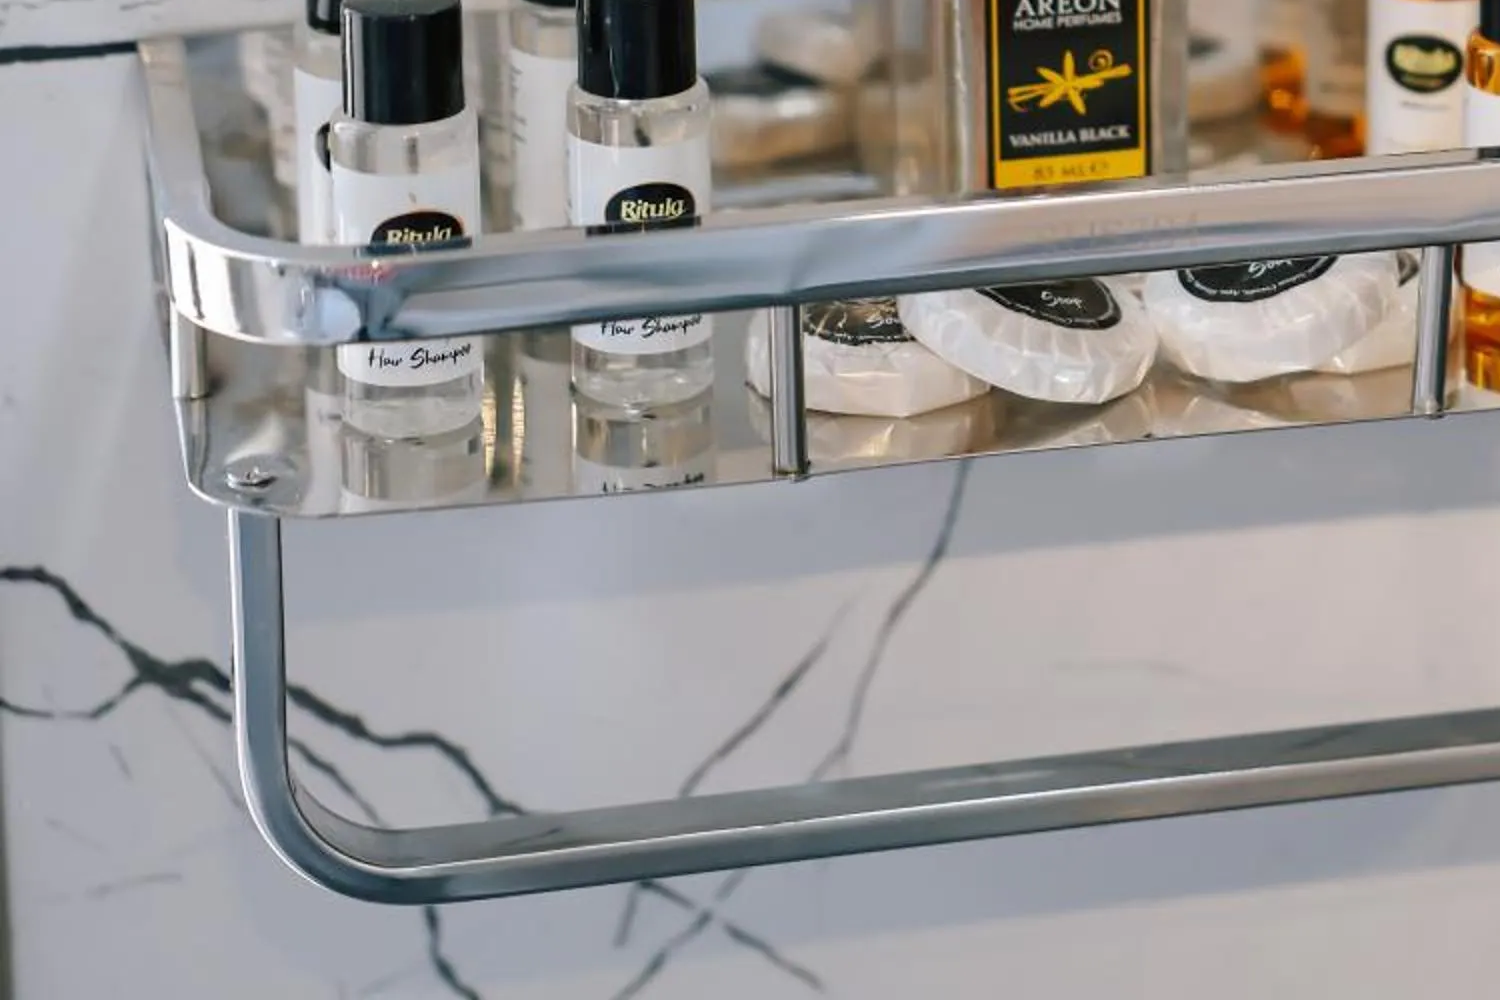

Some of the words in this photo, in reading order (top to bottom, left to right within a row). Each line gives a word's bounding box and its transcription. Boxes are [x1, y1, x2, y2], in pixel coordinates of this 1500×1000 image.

[1013, 16, 1053, 31] HOME
[1057, 11, 1122, 28] PERFUMES
[1009, 131, 1077, 147] VANILLA
[1080, 125, 1131, 142] BLACK
